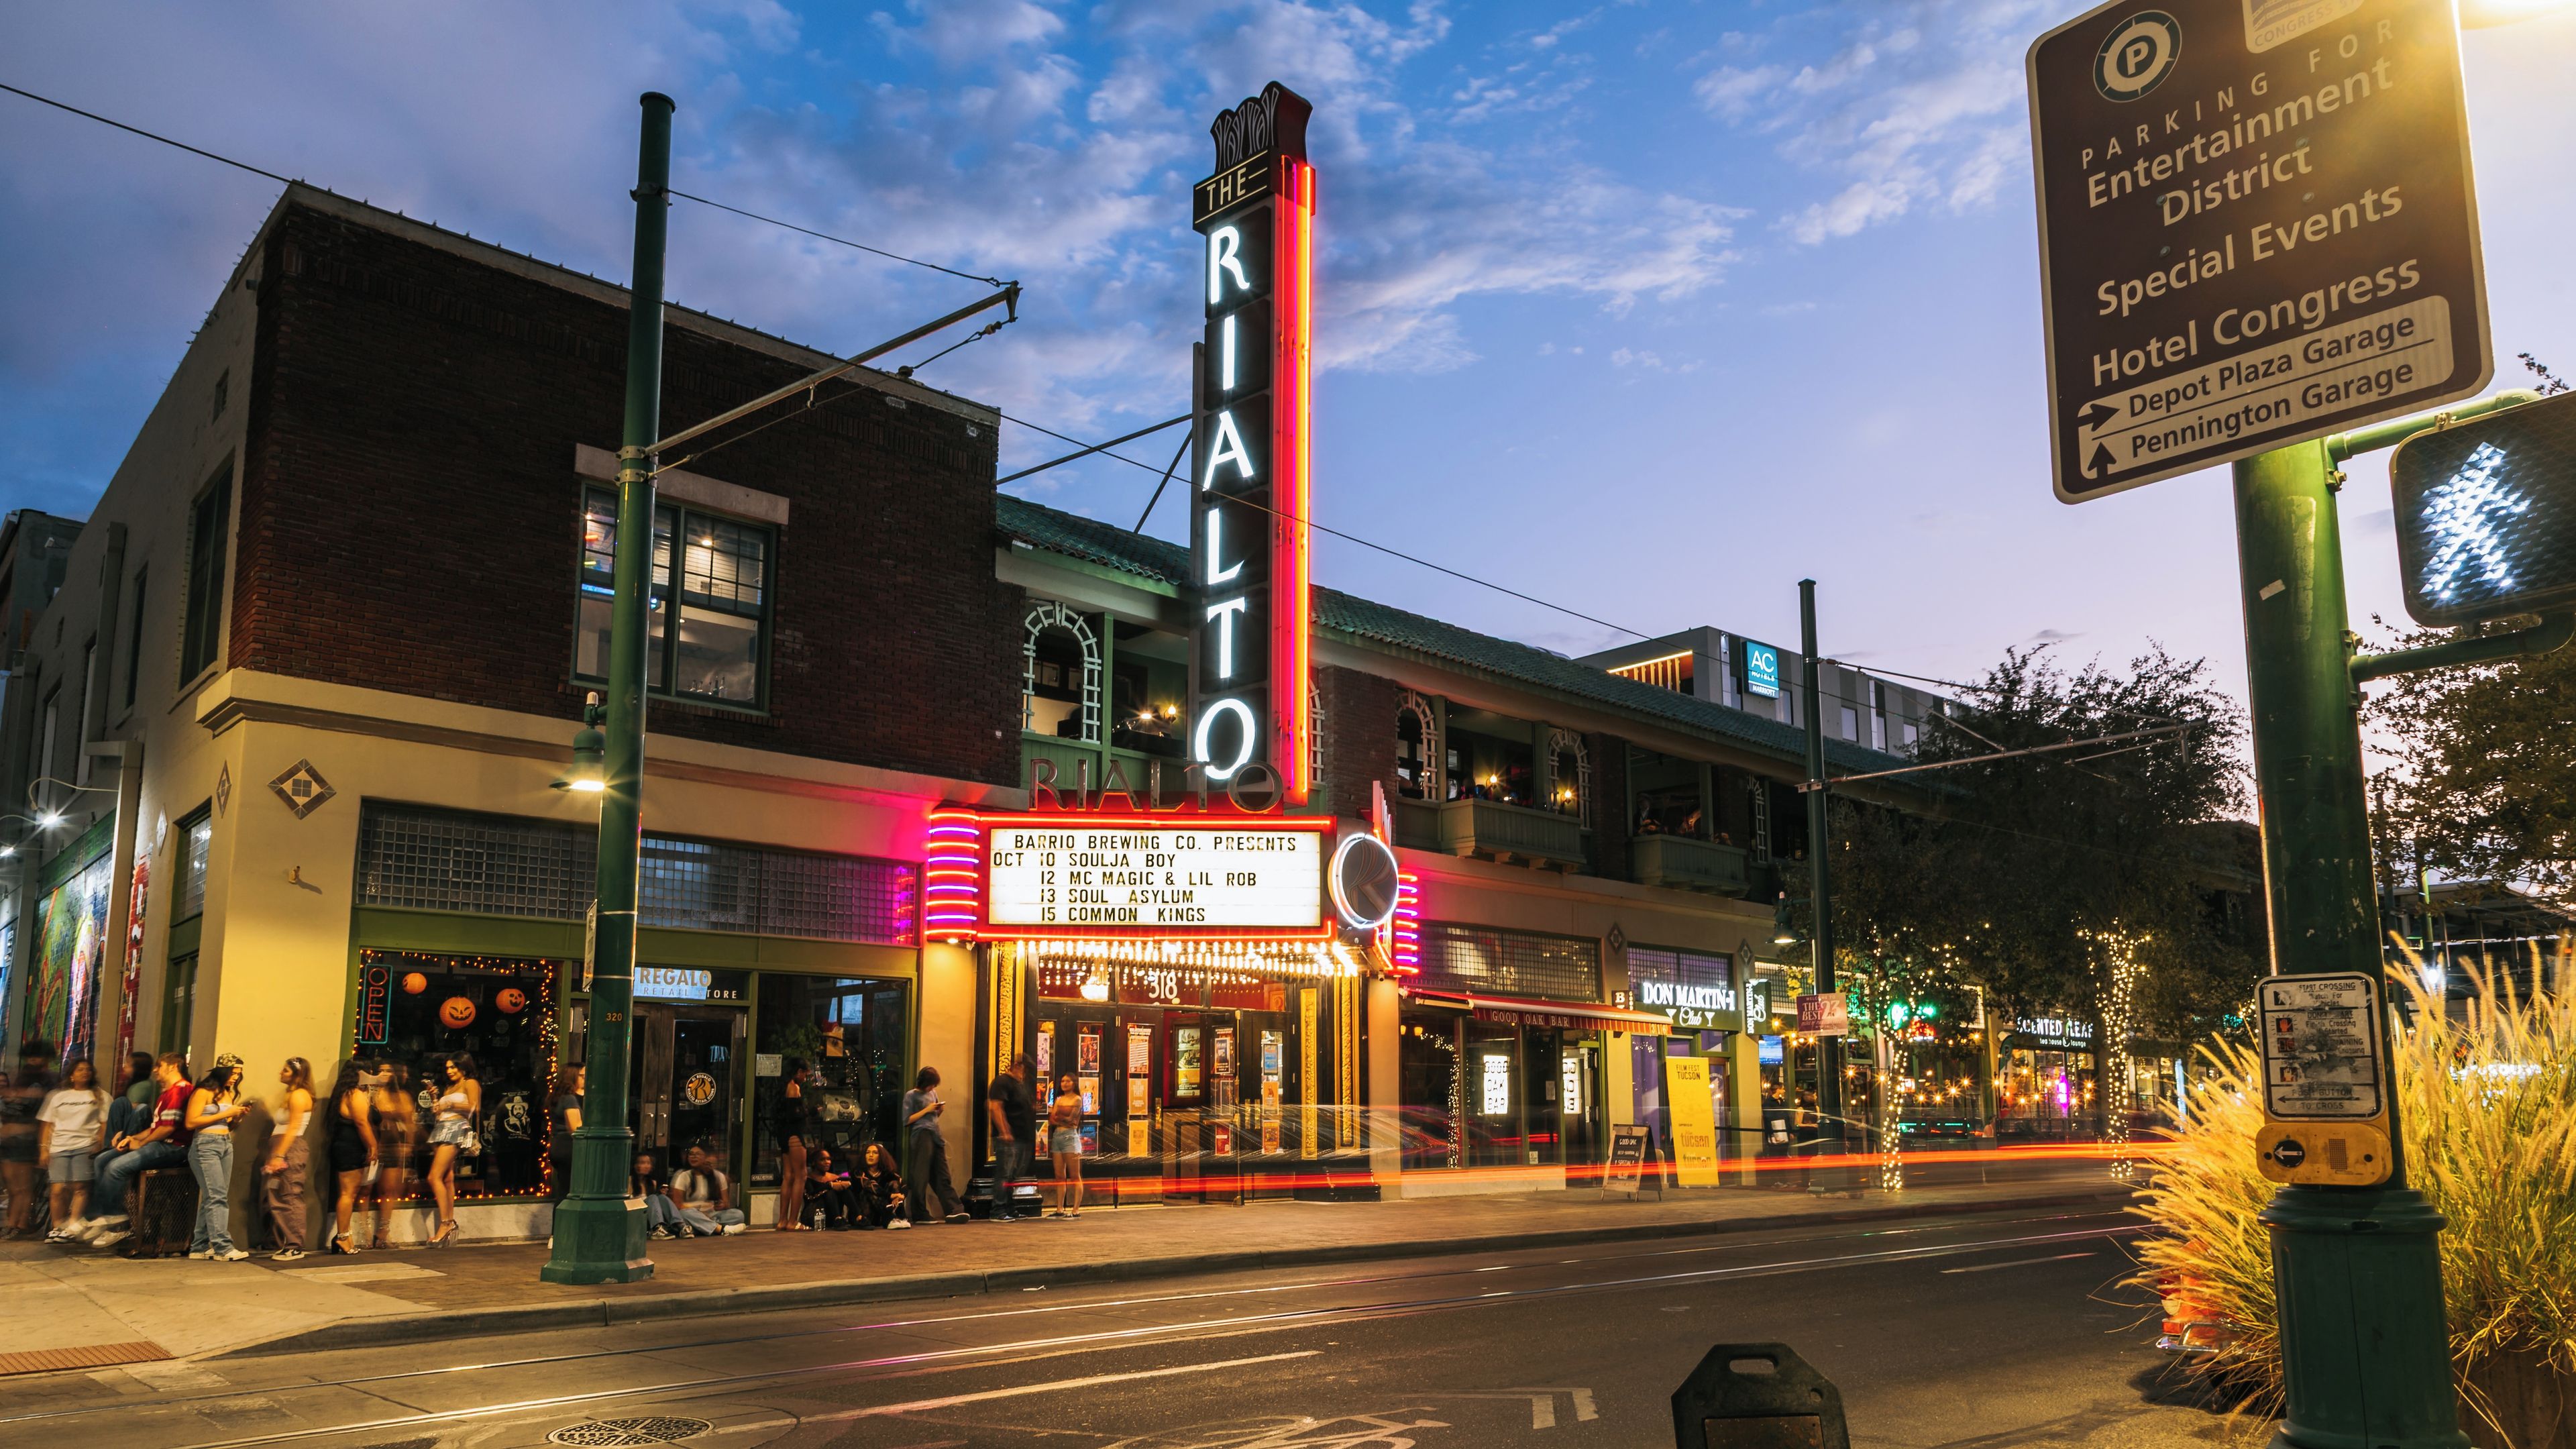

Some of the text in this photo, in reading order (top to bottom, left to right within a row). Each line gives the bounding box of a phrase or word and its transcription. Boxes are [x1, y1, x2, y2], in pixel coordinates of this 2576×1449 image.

[2126, 41, 2148, 78] P
[2082, 19, 2393, 169] PARKING FOR
[2088, 56, 2394, 208] Entertainment
[1207, 167, 1247, 211] THE
[2162, 144, 2312, 227] District
[2098, 184, 2403, 317] Special Events
[2093, 258, 2420, 388] Hotel Congress
[2129, 313, 2415, 419] Depot Plaza Garage
[2131, 360, 2414, 458] Pennington Garage
[1195, 225, 1256, 780] RIALTO
[1751, 650, 1774, 673] AC
[1752, 671, 1776, 682] HOTELS
[1752, 685, 1776, 697] MARRIOTT
[1029, 758, 1283, 814] RIALTO
[1014, 835, 1297, 851] BARRIO BREWING CO. PRESENTS
[993, 852, 1175, 868] OCT 10 SOULJA BOY
[1040, 871, 1257, 886] 12 MC MAGIC & LIL ROB
[1040, 889, 1194, 904] 13 SOUL ASYLUM
[1041, 907, 1205, 922] 15 COMMON KINGS
[640, 967, 712, 987] REGALO
[1148, 971, 1177, 999] 318
[2318, 982, 2356, 990] CROSSING
[644, 987, 737, 999] RETAIL STORE
[1644, 982, 1674, 1005] DON
[365, 967, 387, 1040] OPEN
[1803, 1002, 1820, 1011] THE
[606, 1013, 623, 1021] 320
[1492, 1010, 1569, 1027] GOOD OAK BAR
[1679, 1006, 1702, 1026] Club
[1802, 1010, 1822, 1020] BEST
[2328, 1019, 2357, 1028] Crossing
[2017, 1016, 2062, 1036] SCENTED
[1677, 1072, 1701, 1080] TUCSON
[2316, 1102, 2345, 1110] CROSS
